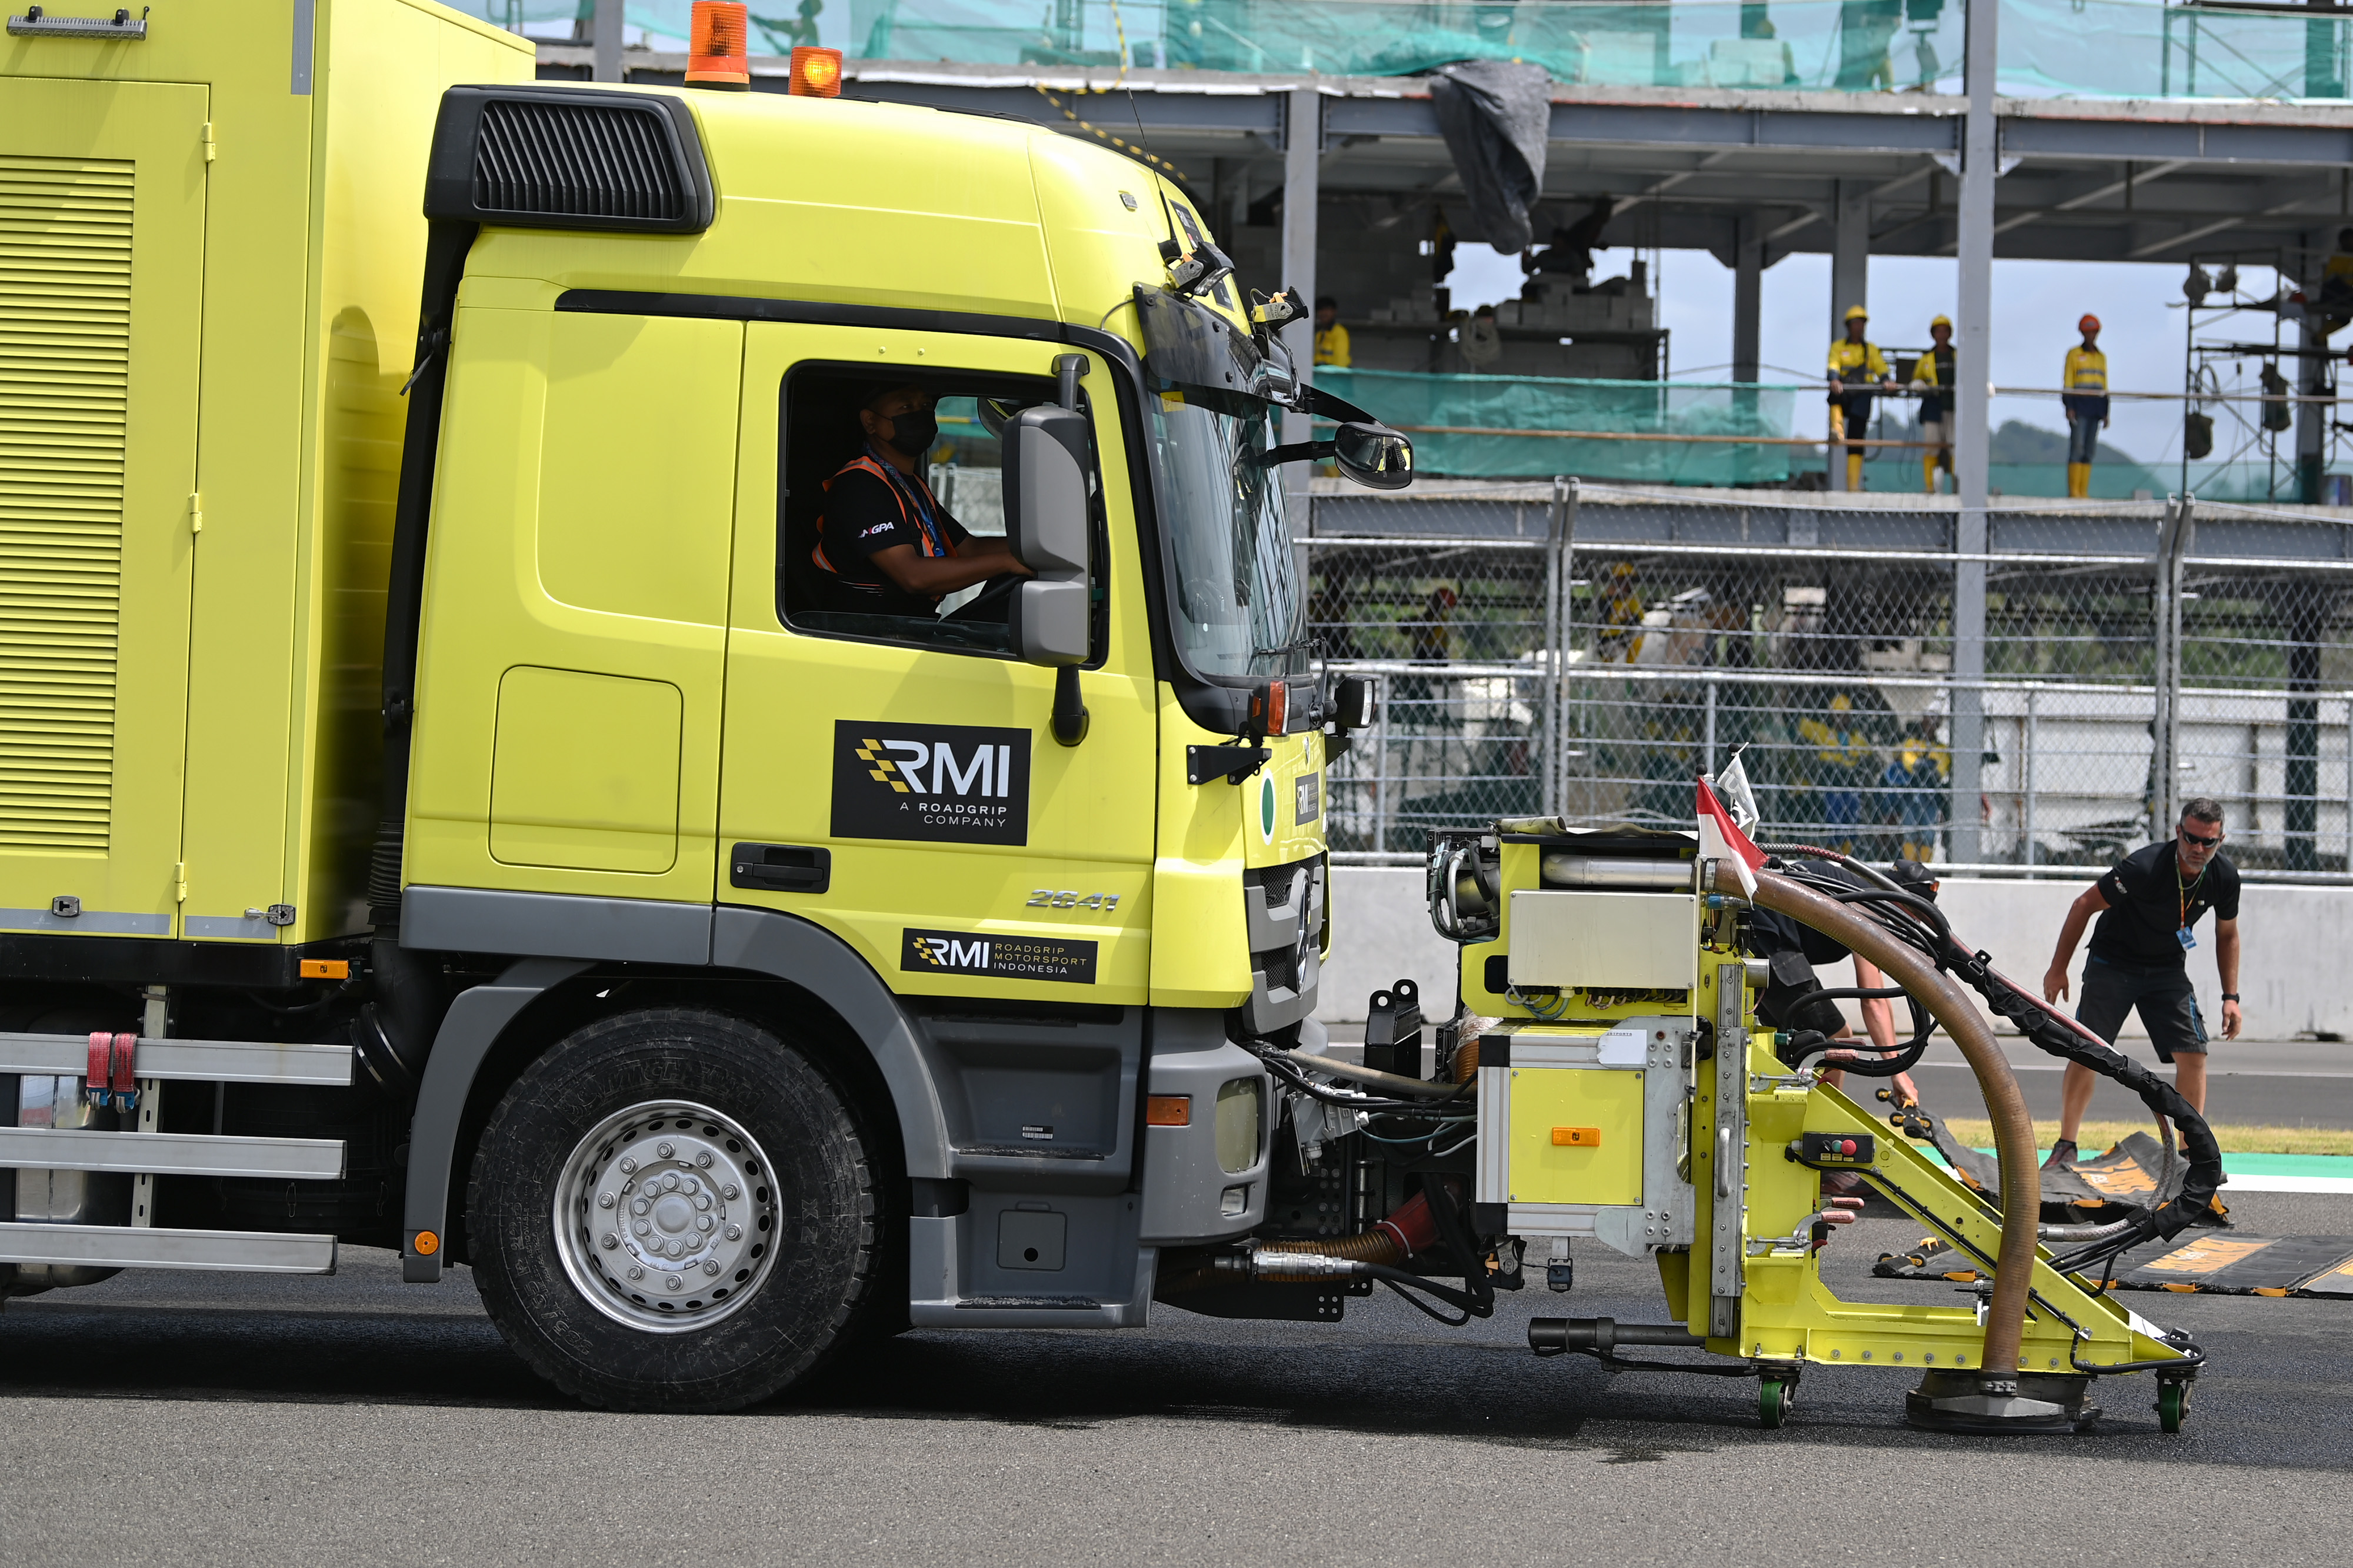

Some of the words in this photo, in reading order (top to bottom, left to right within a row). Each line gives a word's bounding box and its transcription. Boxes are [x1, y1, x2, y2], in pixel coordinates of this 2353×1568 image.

[882, 739, 1011, 798] RMI
[899, 802, 909, 811] A
[919, 802, 1007, 815] ROADGRIP
[924, 814, 1006, 828] COMPANY
[1026, 889, 1120, 911] 2641
[926, 938, 989, 968] RMI
[994, 943, 1065, 955] ROADGRIP
[994, 953, 1088, 966] MOTORSPORT
[994, 962, 1068, 975] INDONESIA
